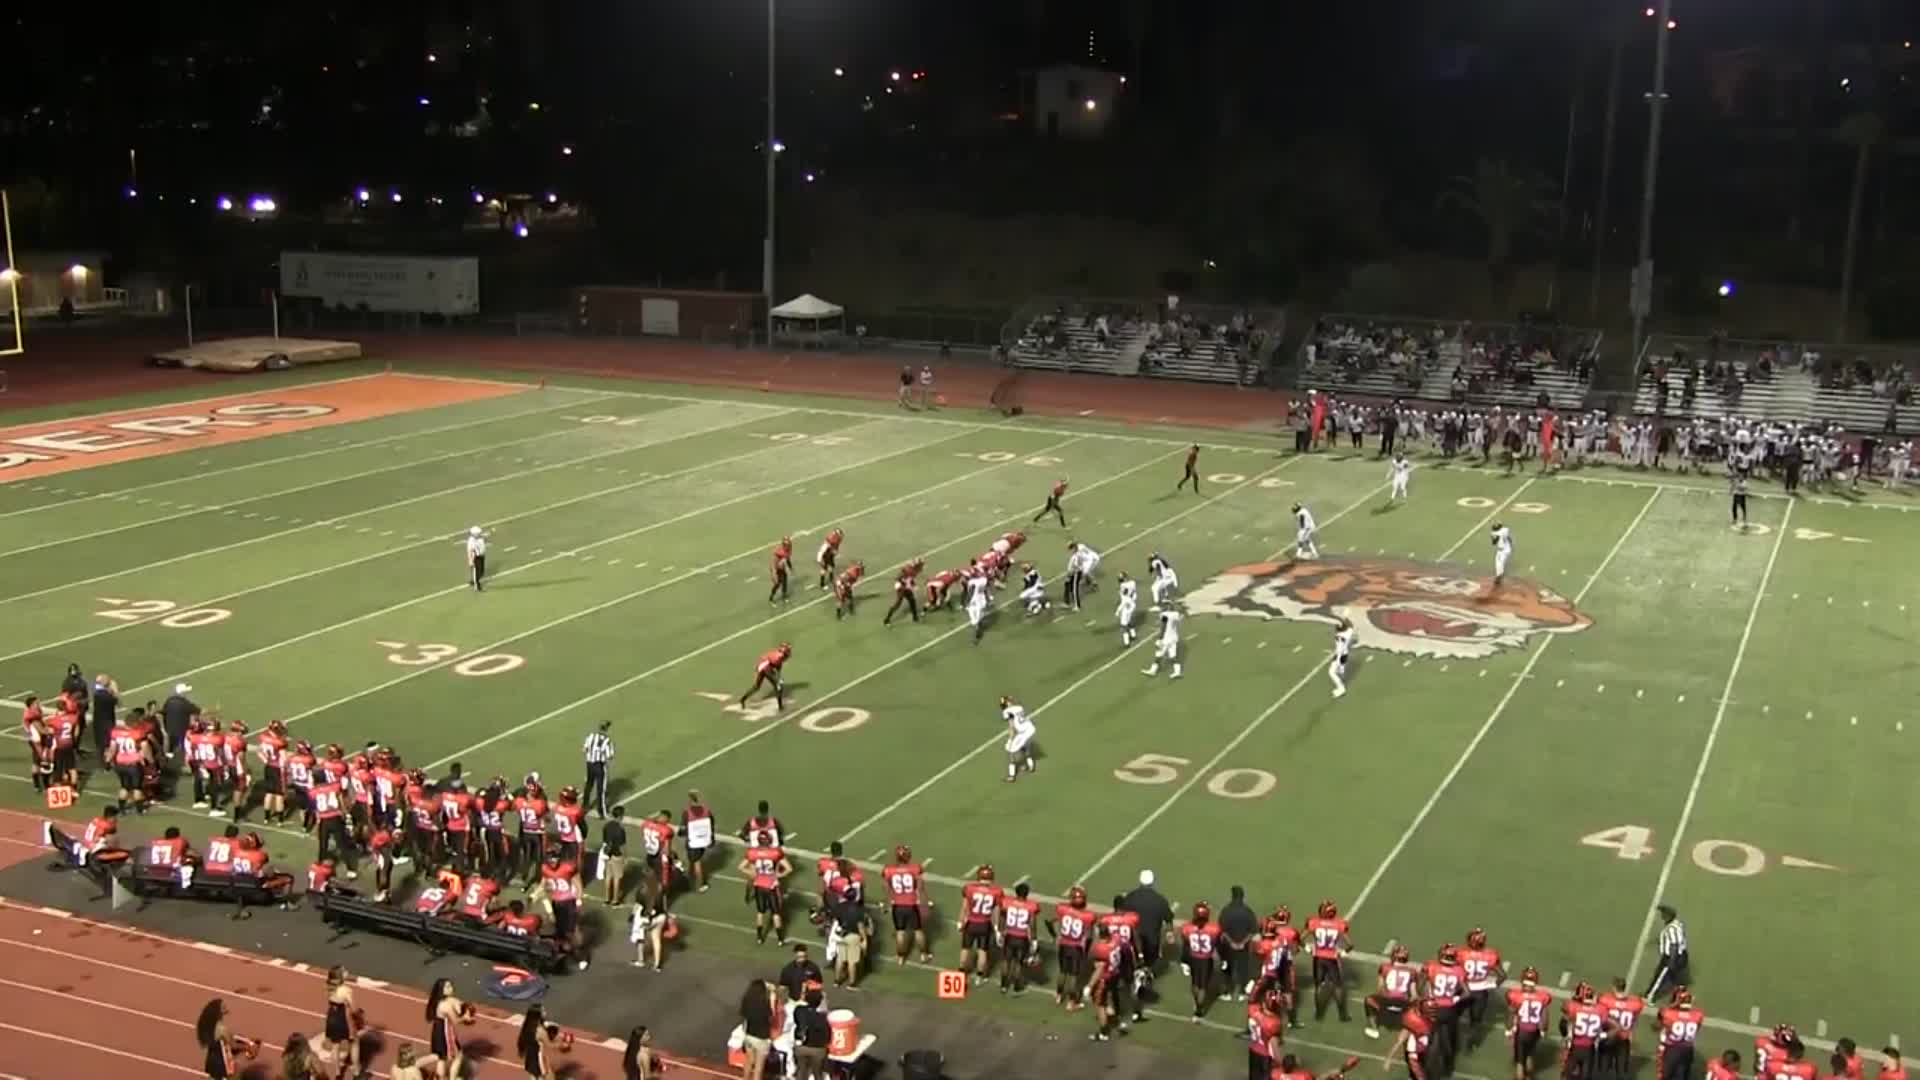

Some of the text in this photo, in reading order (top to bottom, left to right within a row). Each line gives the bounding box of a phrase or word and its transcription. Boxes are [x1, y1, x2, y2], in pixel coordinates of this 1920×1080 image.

[388, 643, 523, 676] 30
[1113, 753, 1277, 798] 50
[51, 789, 69, 804] 30
[1581, 825, 1765, 876] 40
[892, 873, 914, 893] 69
[972, 893, 994, 914] 72
[1006, 907, 1029, 928] 62
[1061, 914, 1083, 938] 99
[1315, 927, 1338, 948] 97
[1464, 961, 1488, 979] 95
[943, 975, 961, 993] 50
[1518, 1001, 1542, 1023] 43
[1574, 1013, 1601, 1036] 52
[1670, 1021, 1698, 1041] 98
